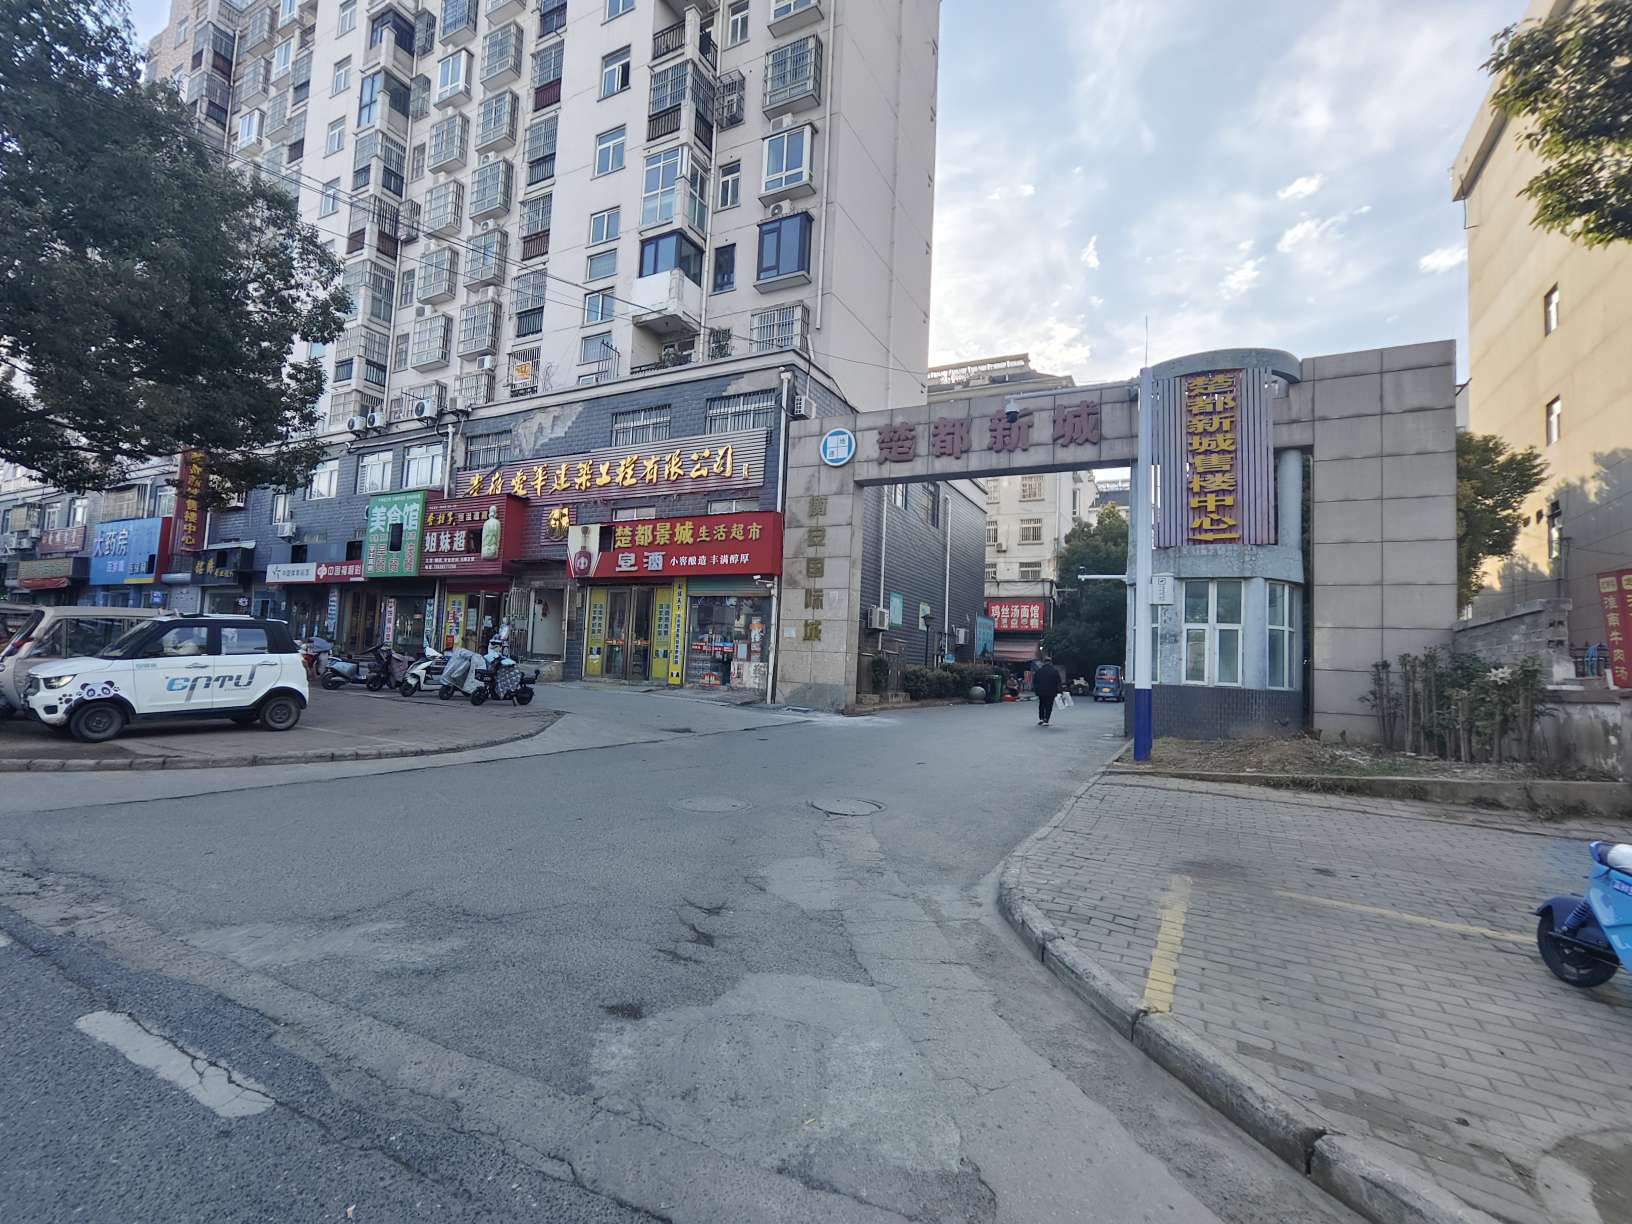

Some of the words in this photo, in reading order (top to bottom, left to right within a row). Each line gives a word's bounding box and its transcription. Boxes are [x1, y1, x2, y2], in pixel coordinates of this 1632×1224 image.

[877, 400, 1099, 465] 楚都新城
[1187, 374, 1237, 530] 楚都新城售楼中心
[369, 503, 420, 533] 美食馆
[93, 529, 128, 557] 大药房
[615, 521, 694, 549] 楚都景城
[697, 522, 763, 542] 生活超市
[991, 604, 1040, 618] 鸡丝汤面馆
[1603, 595, 1628, 681] 淮南牛肉汤
